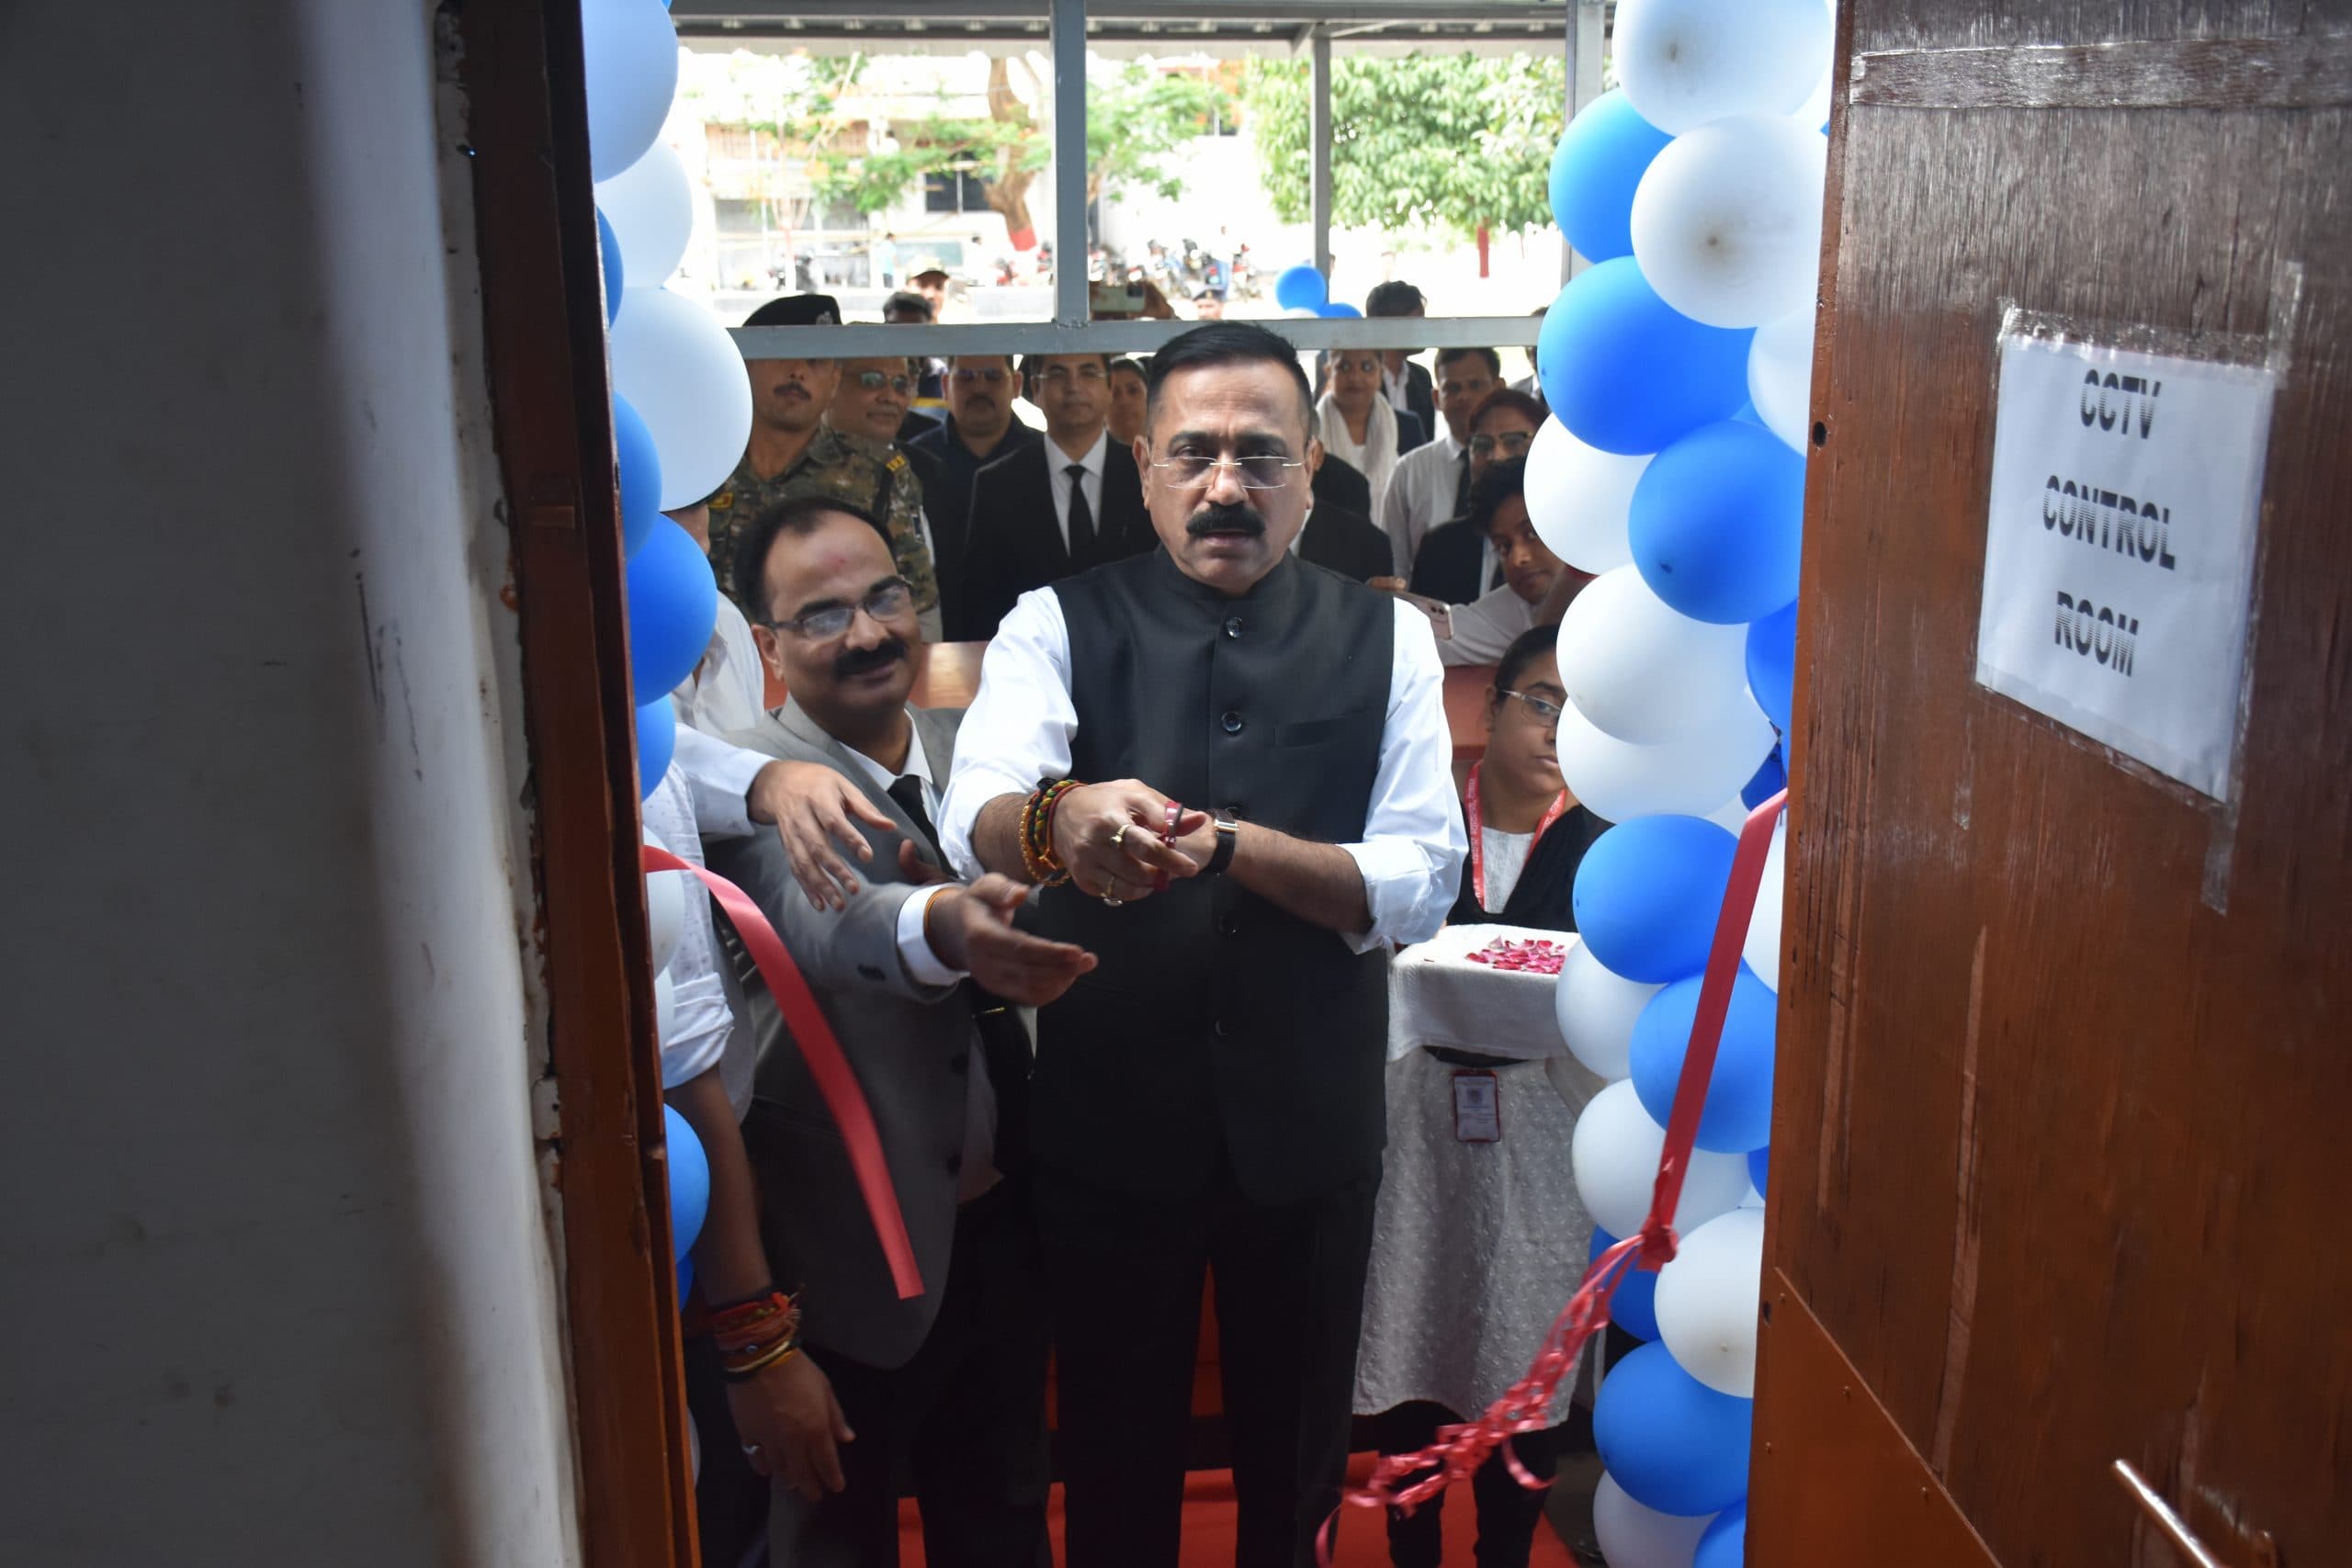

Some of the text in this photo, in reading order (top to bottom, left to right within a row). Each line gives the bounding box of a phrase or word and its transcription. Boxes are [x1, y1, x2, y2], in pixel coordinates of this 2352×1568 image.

[2080, 368, 2161, 439] CCTV
[2042, 475, 2176, 570] CONTROL
[2054, 591, 2139, 677] ROOM
